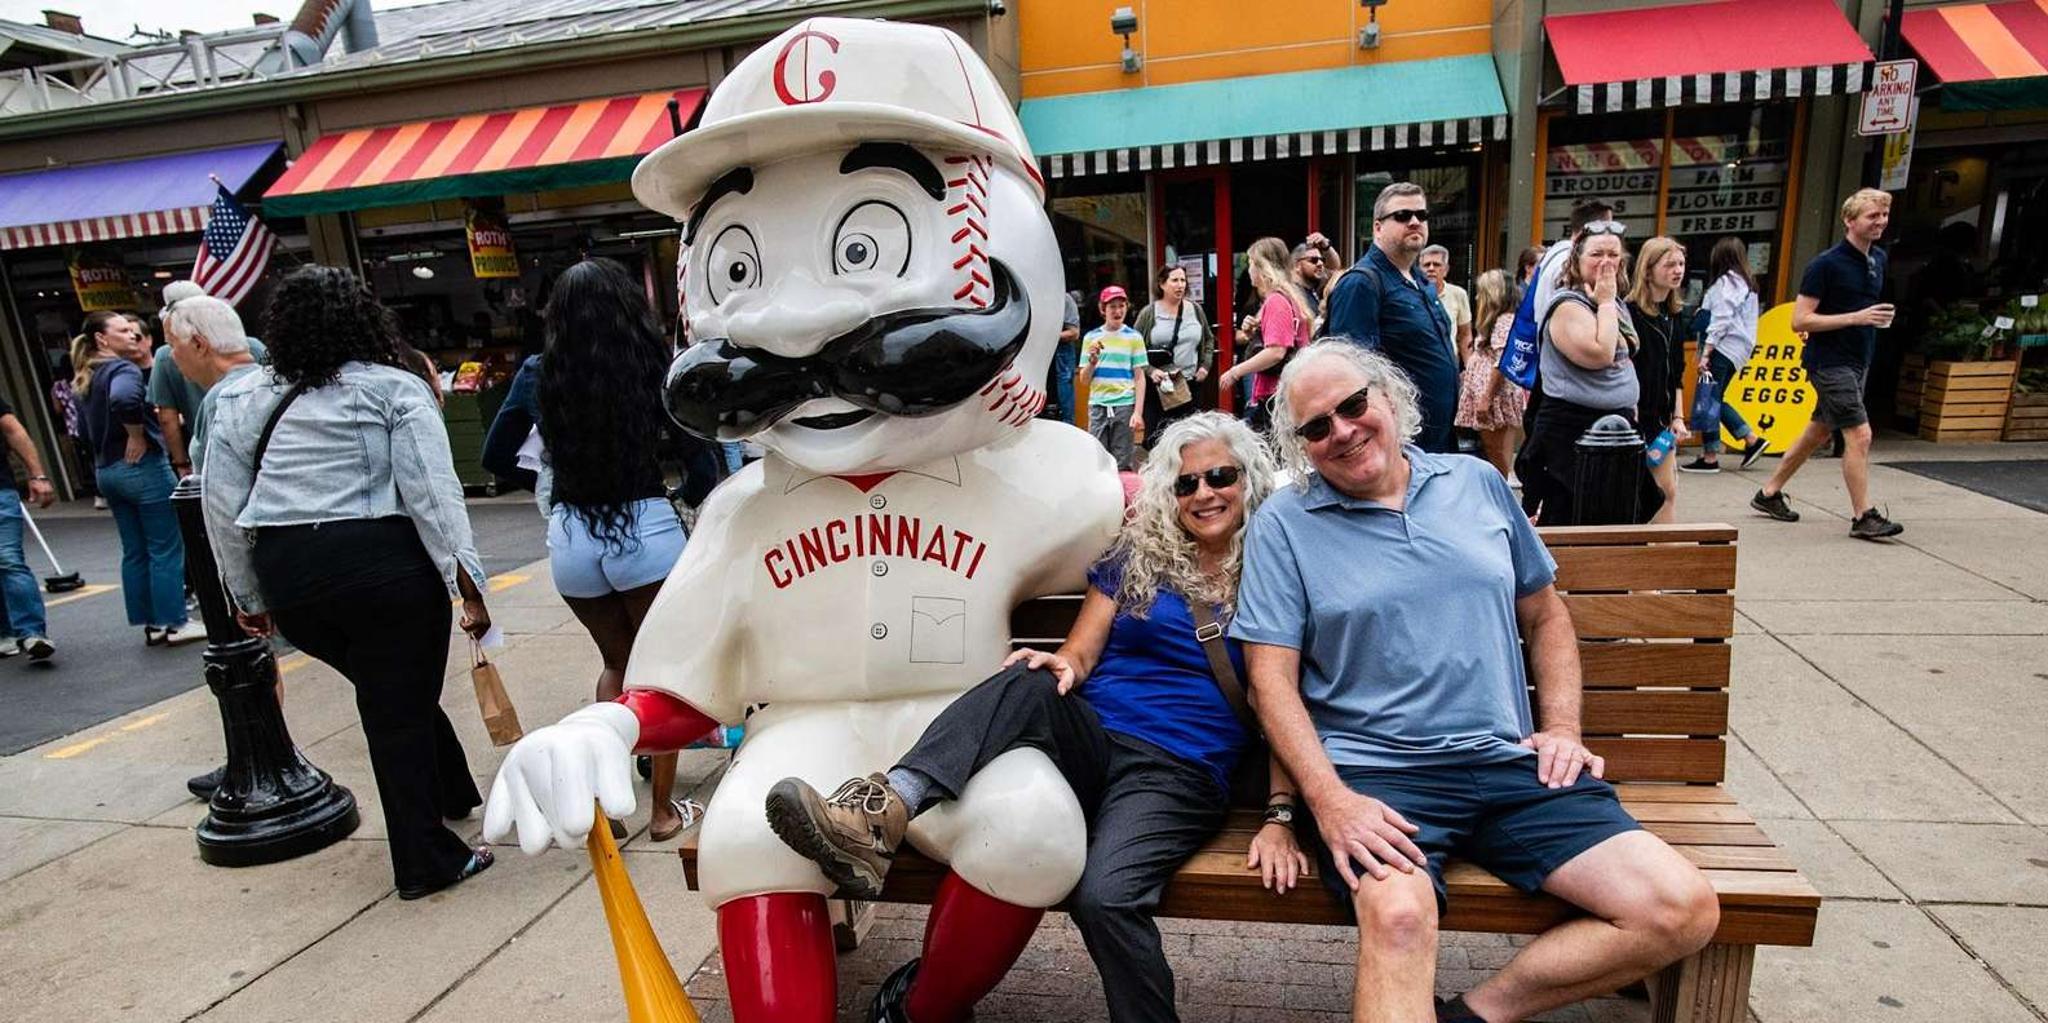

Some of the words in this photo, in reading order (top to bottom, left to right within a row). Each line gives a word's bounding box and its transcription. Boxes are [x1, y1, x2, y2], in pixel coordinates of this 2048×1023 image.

[774, 31, 840, 106] C
[1865, 80, 1910, 97] ARKING
[1552, 174, 1655, 192] PRODUCE
[1668, 190, 1774, 210] FLOWERS
[1681, 215, 1755, 232] FRESH
[1750, 344, 1804, 361] FAR
[1738, 366, 1808, 383] FRES
[1742, 387, 1806, 405] EGGS
[764, 513, 987, 590] CINCINNATI
